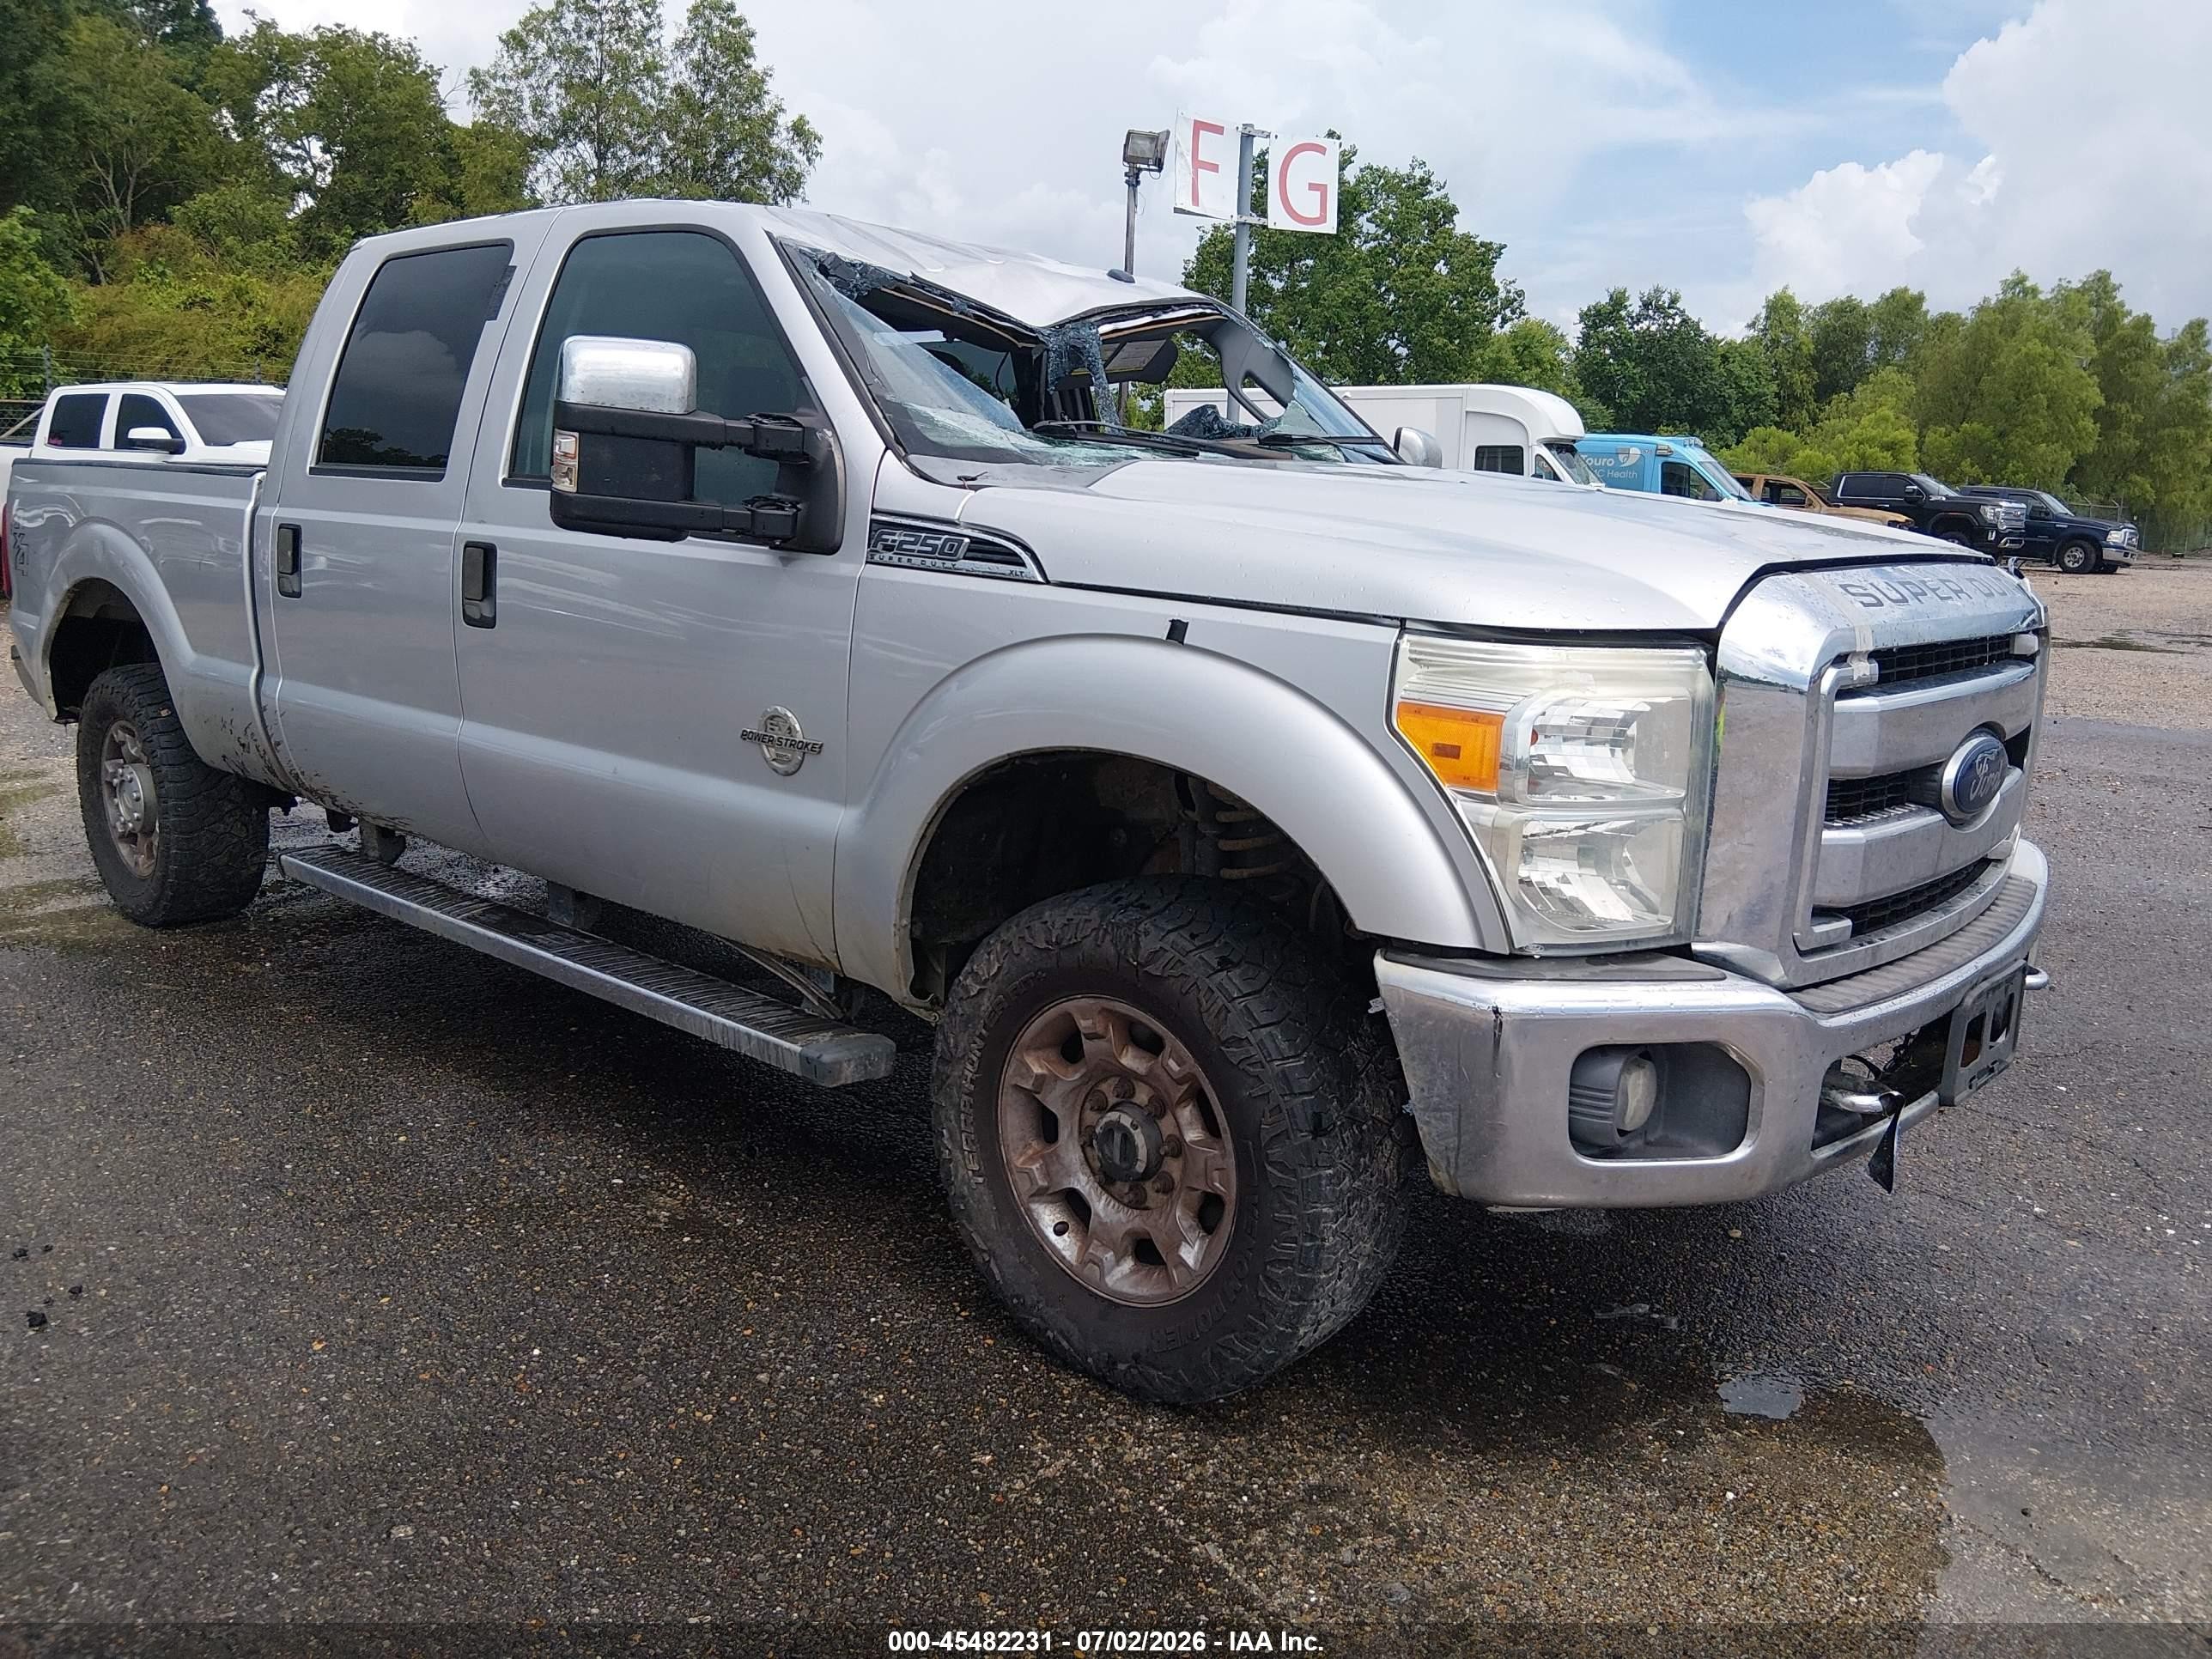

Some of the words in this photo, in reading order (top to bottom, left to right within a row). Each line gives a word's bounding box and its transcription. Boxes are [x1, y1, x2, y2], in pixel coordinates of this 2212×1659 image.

[1191, 118, 1224, 207] F
[1279, 142, 1328, 227] G
[1580, 454, 1615, 467] Touro
[1607, 469, 1638, 479] Health
[870, 530, 970, 560] F-250
[869, 553, 913, 564] SUPER
[921, 559, 957, 571] DUTY
[1007, 569, 1025, 578] XLT
[1838, 578, 1973, 608] SUPER
[740, 729, 775, 744] POWER
[775, 737, 818, 752] STROKE
